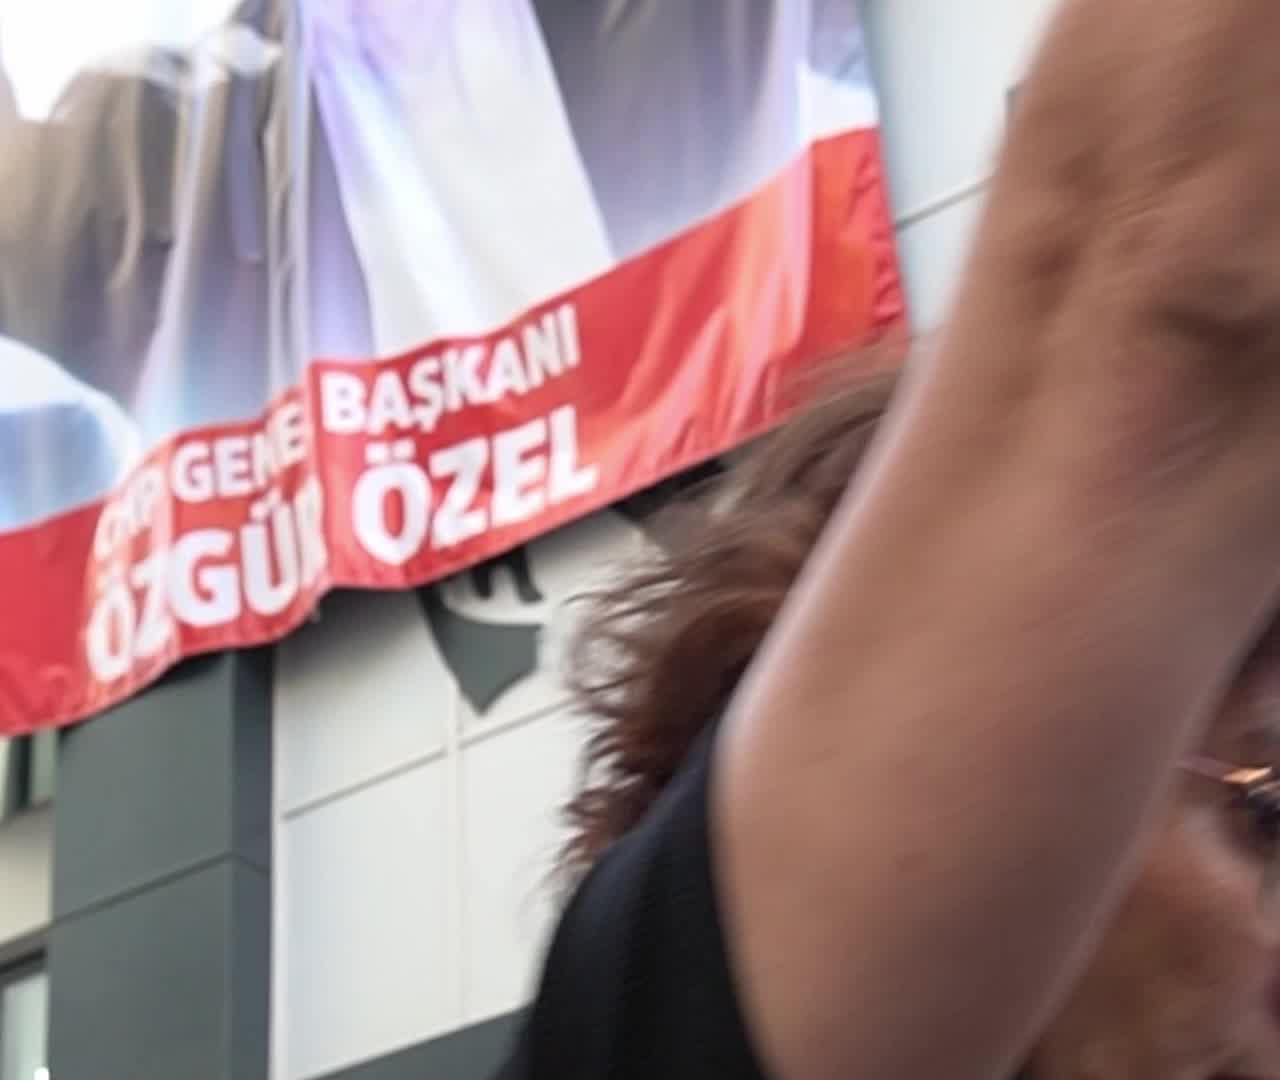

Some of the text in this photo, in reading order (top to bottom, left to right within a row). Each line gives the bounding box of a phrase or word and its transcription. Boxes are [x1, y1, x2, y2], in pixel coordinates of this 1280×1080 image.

[172, 402, 308, 503] GENE
[321, 303, 581, 435] BAŞKANI
[352, 404, 599, 565] ÖZEL
